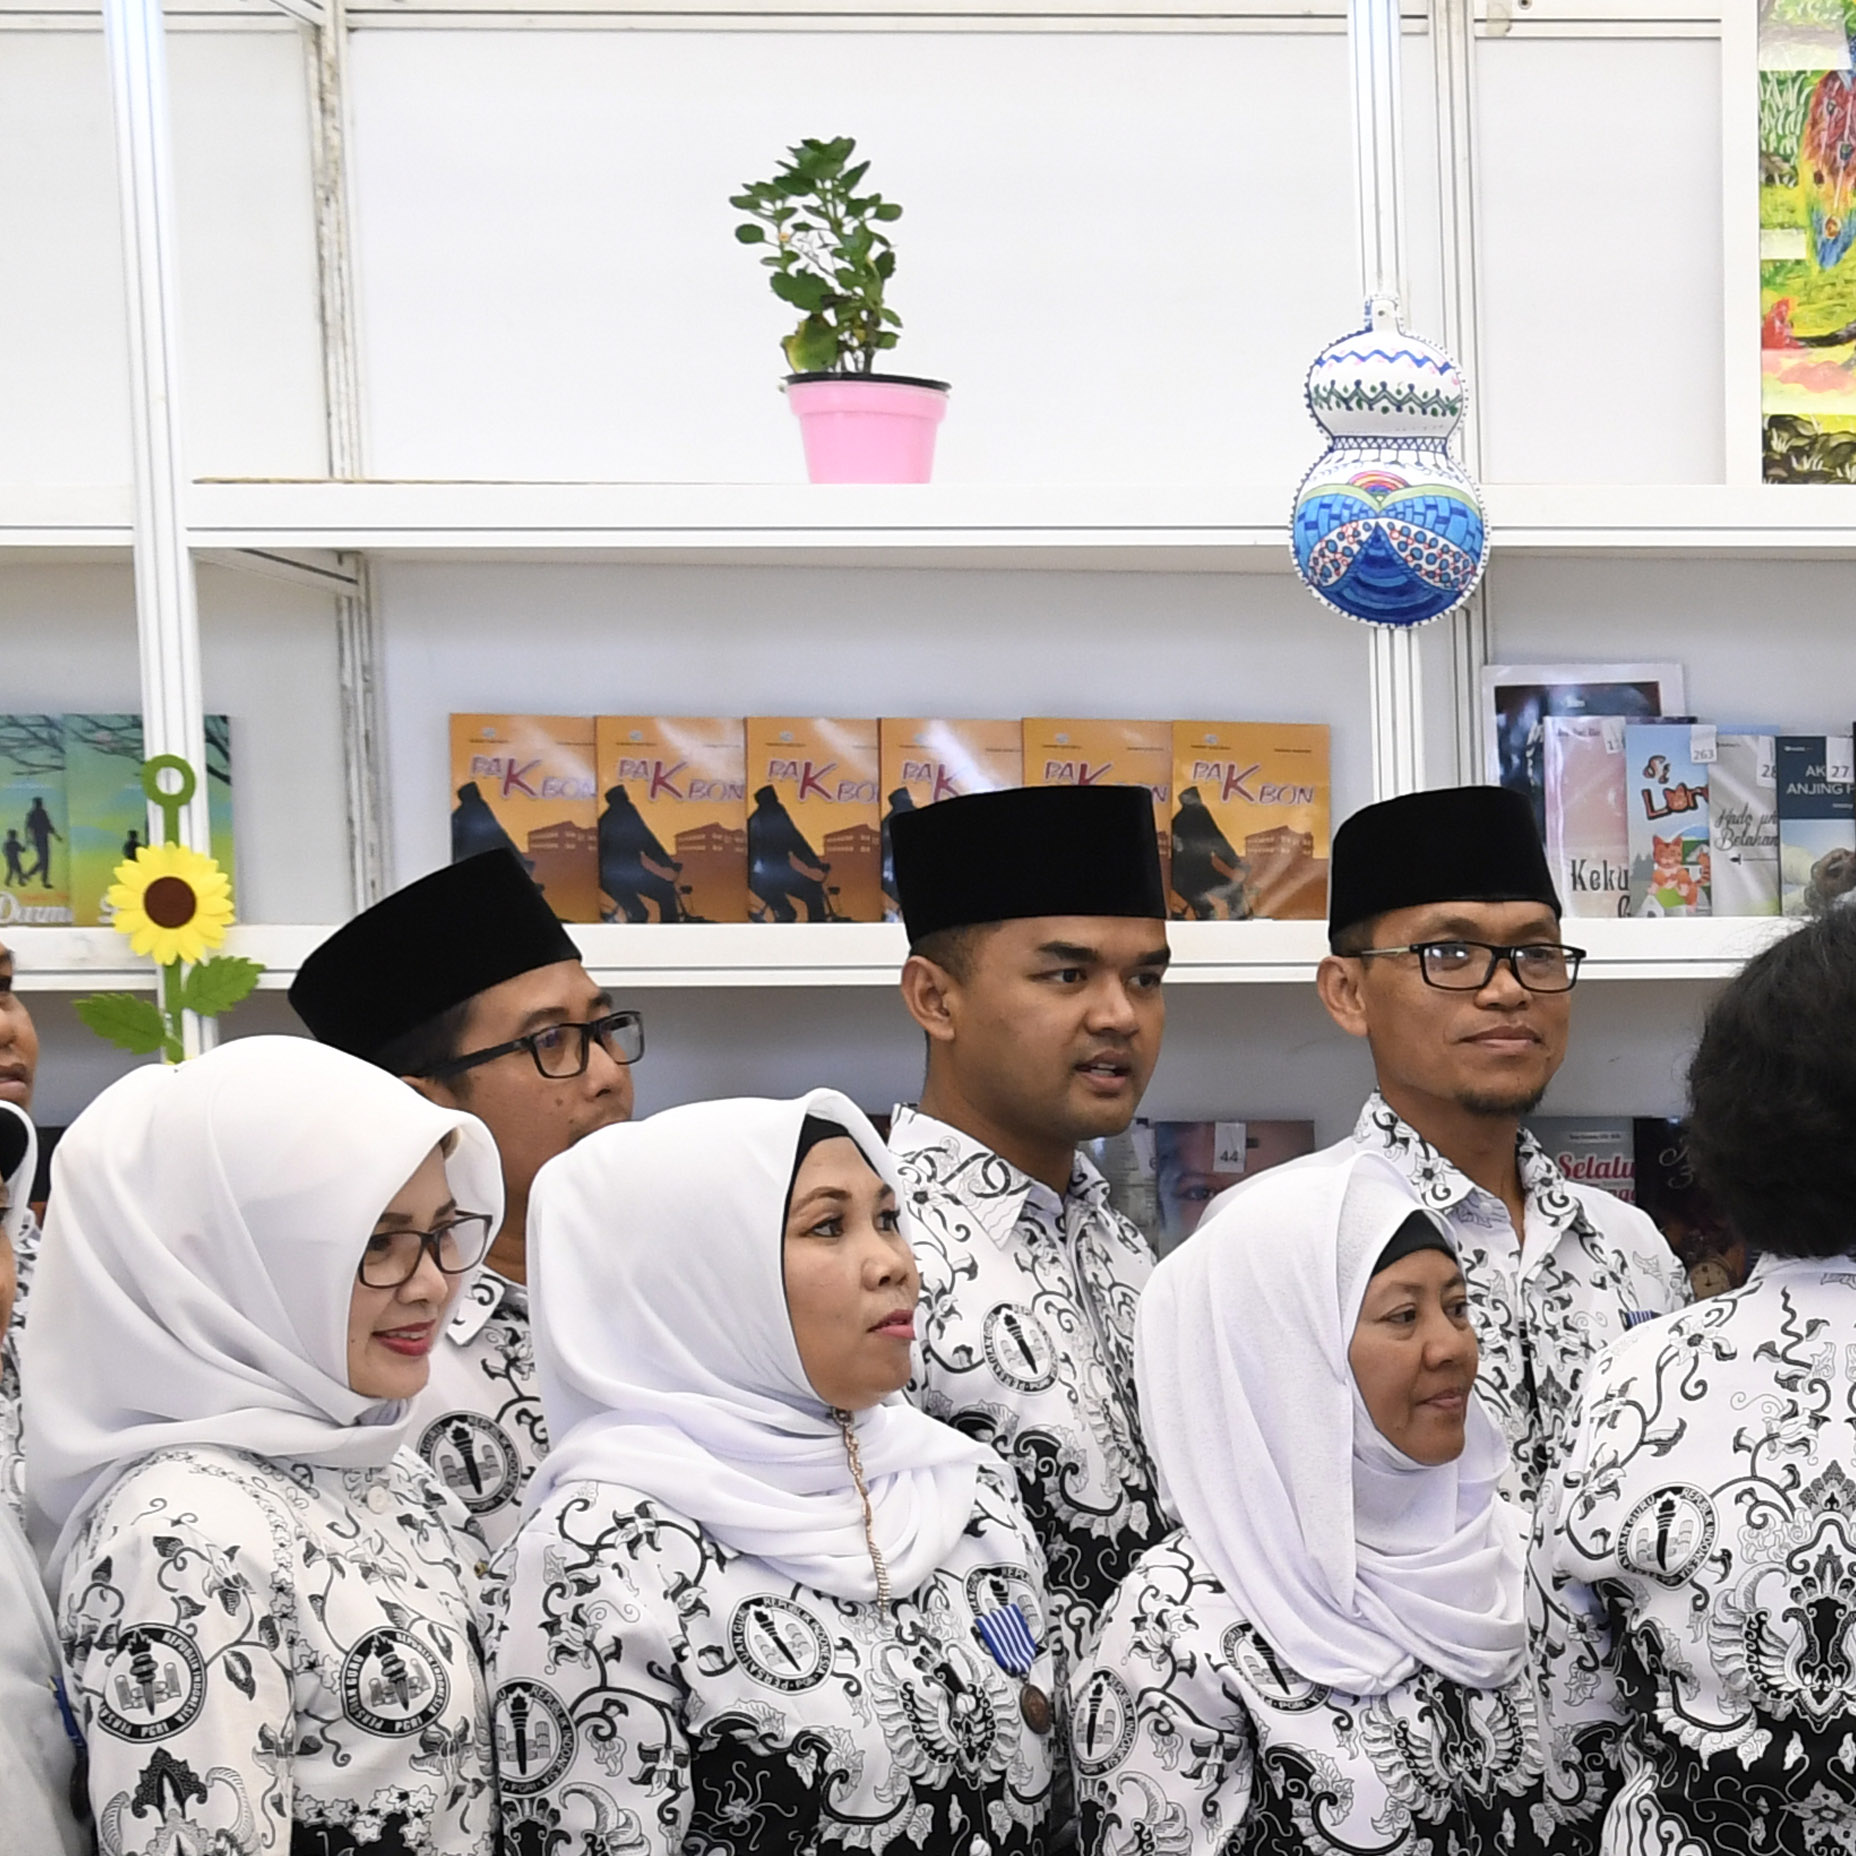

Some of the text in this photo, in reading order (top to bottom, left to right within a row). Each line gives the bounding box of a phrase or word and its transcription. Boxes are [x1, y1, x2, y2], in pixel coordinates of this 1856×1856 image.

[618, 759, 688, 801] PAK
[768, 760, 837, 801] PAK
[1192, 761, 1315, 806] PAK BON
[1786, 783, 1843, 795] ANJING
[1219, 1150, 1239, 1162] 44
[1680, 1487, 1715, 1526] REPUBLIK
[1678, 1525, 1715, 1582] INDONESIA
[345, 1653, 364, 1686] GURU
[732, 1633, 790, 1692] PERSATUAN
[140, 1721, 170, 1738] PGRI
[393, 1716, 424, 1733] PGRI
[529, 1684, 576, 1787] REPUBLIK INDONESIA
